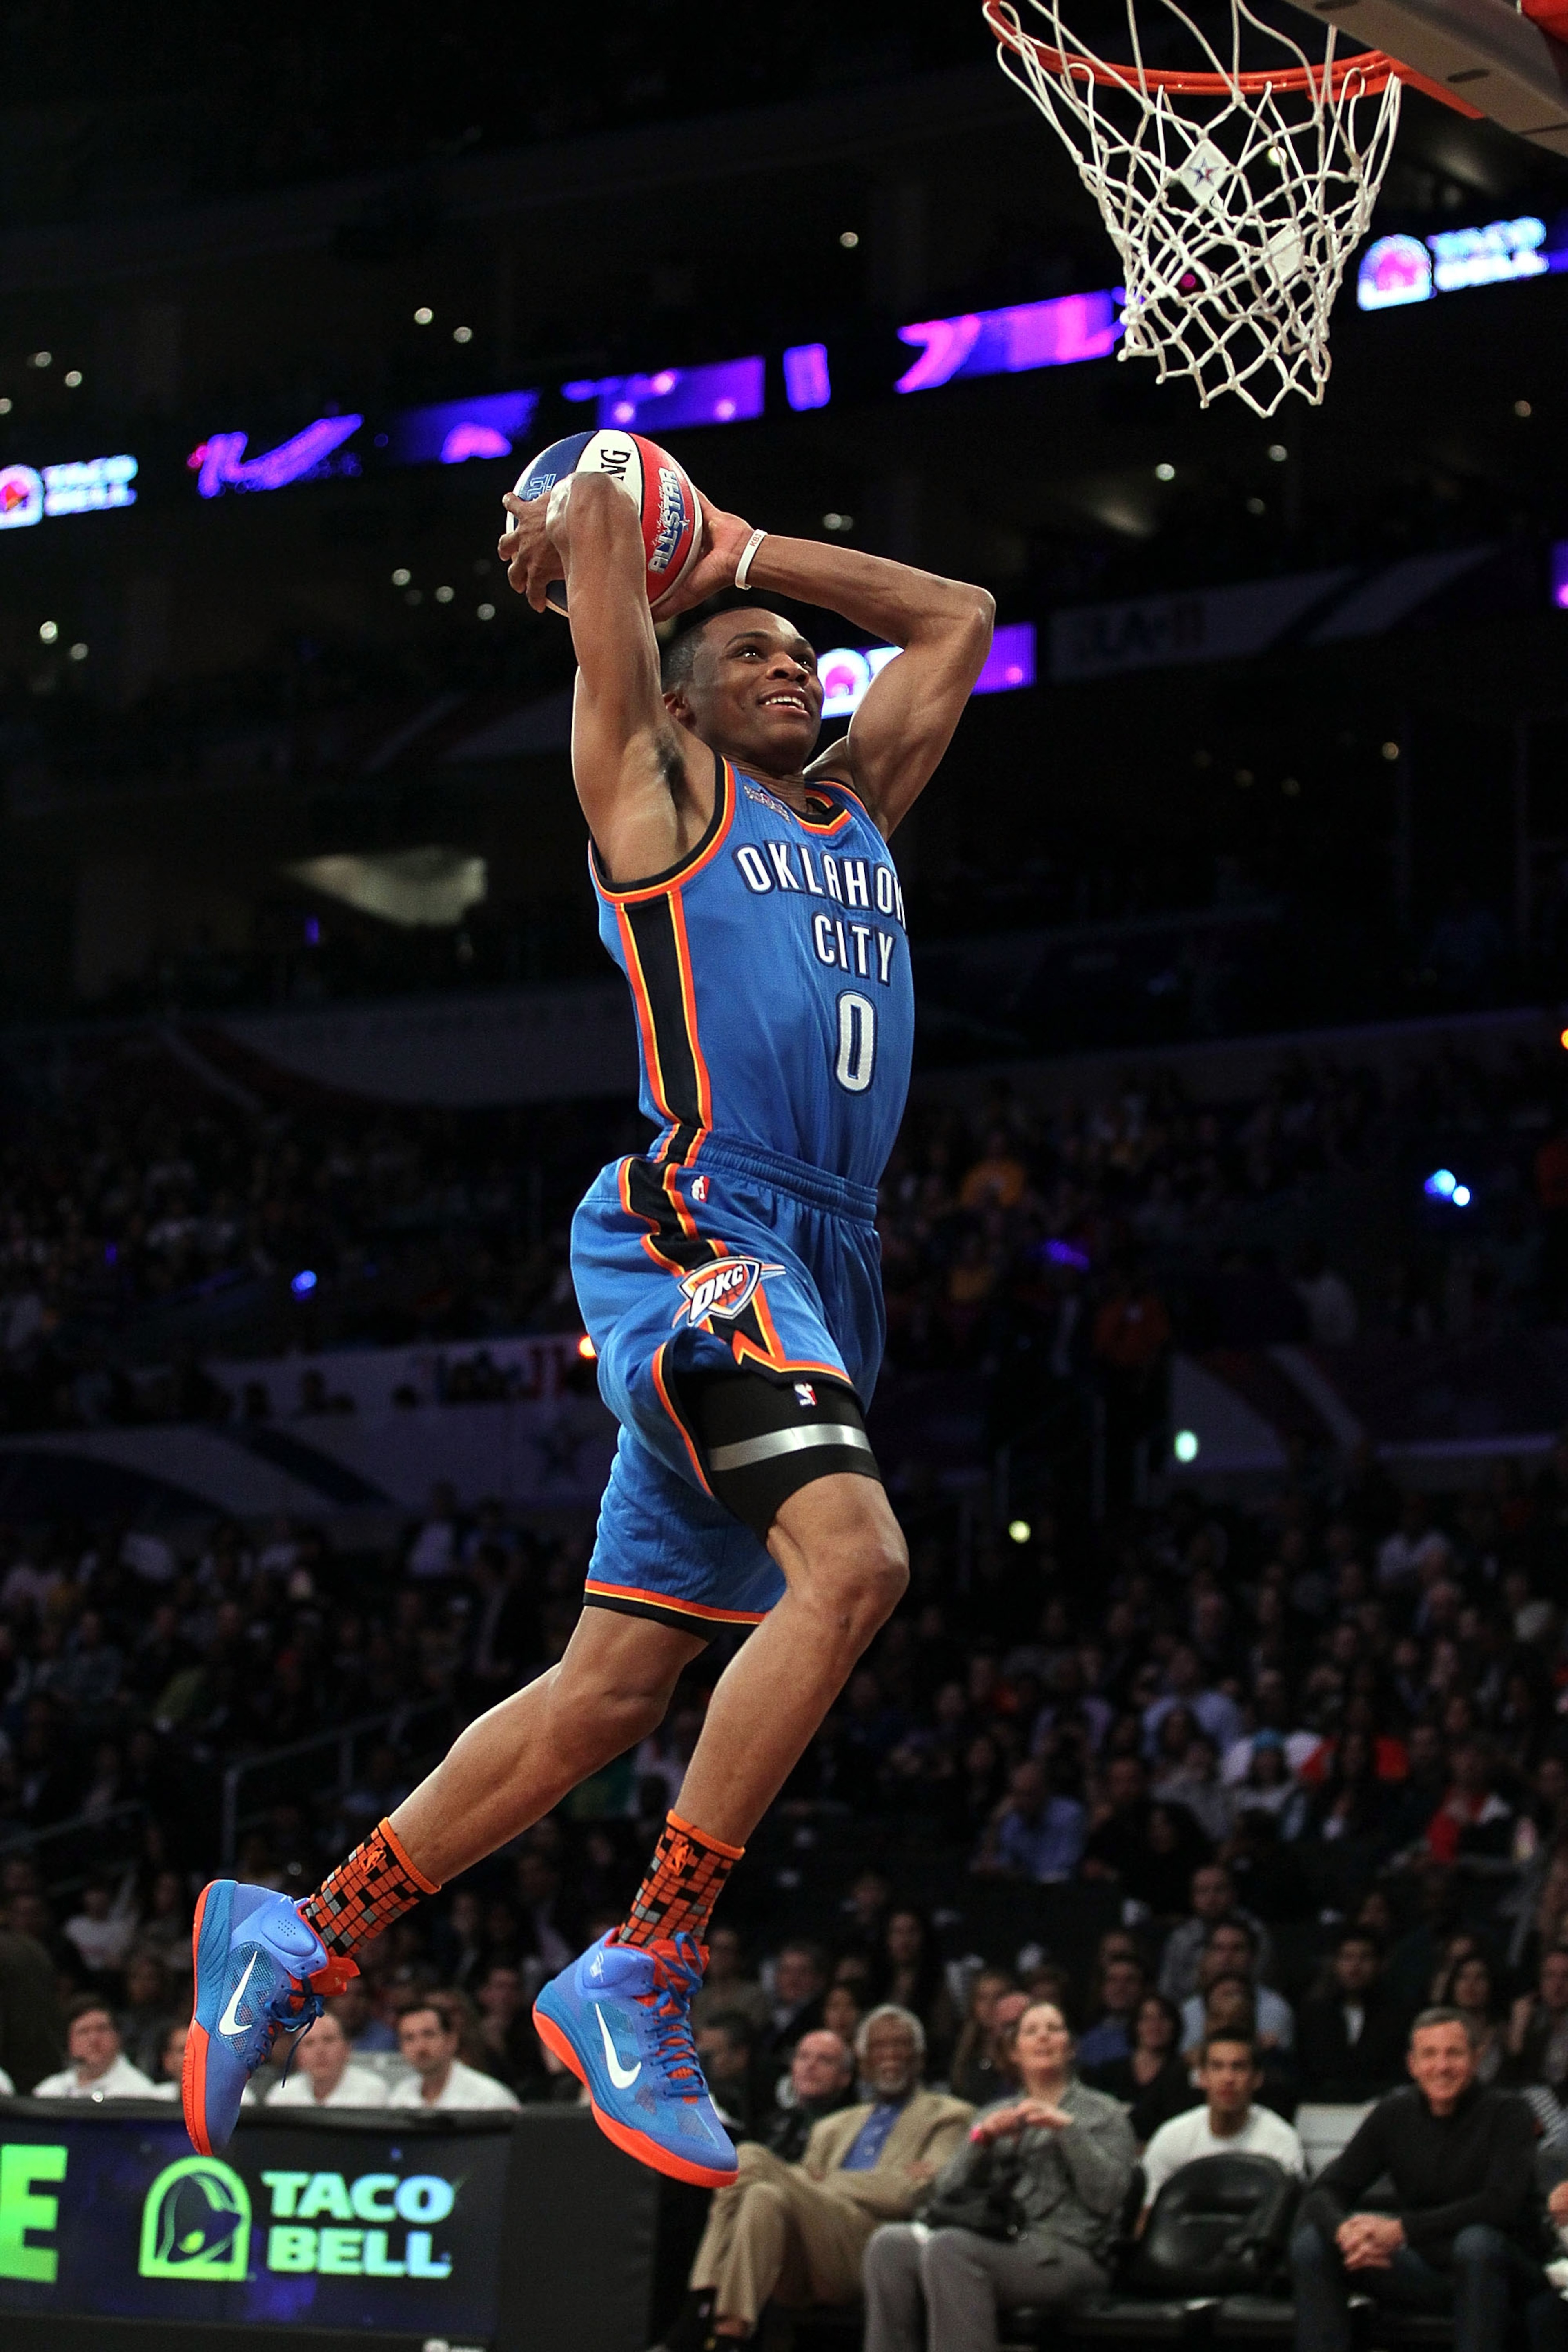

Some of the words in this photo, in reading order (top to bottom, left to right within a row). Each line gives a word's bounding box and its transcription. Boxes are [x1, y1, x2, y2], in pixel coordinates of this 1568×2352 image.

[813, 912, 895, 984] CITY
[835, 990, 875, 1094] 0
[689, 1264, 744, 1321] OKC
[260, 2170, 455, 2225] TACO
[267, 2224, 452, 2280] BELL
